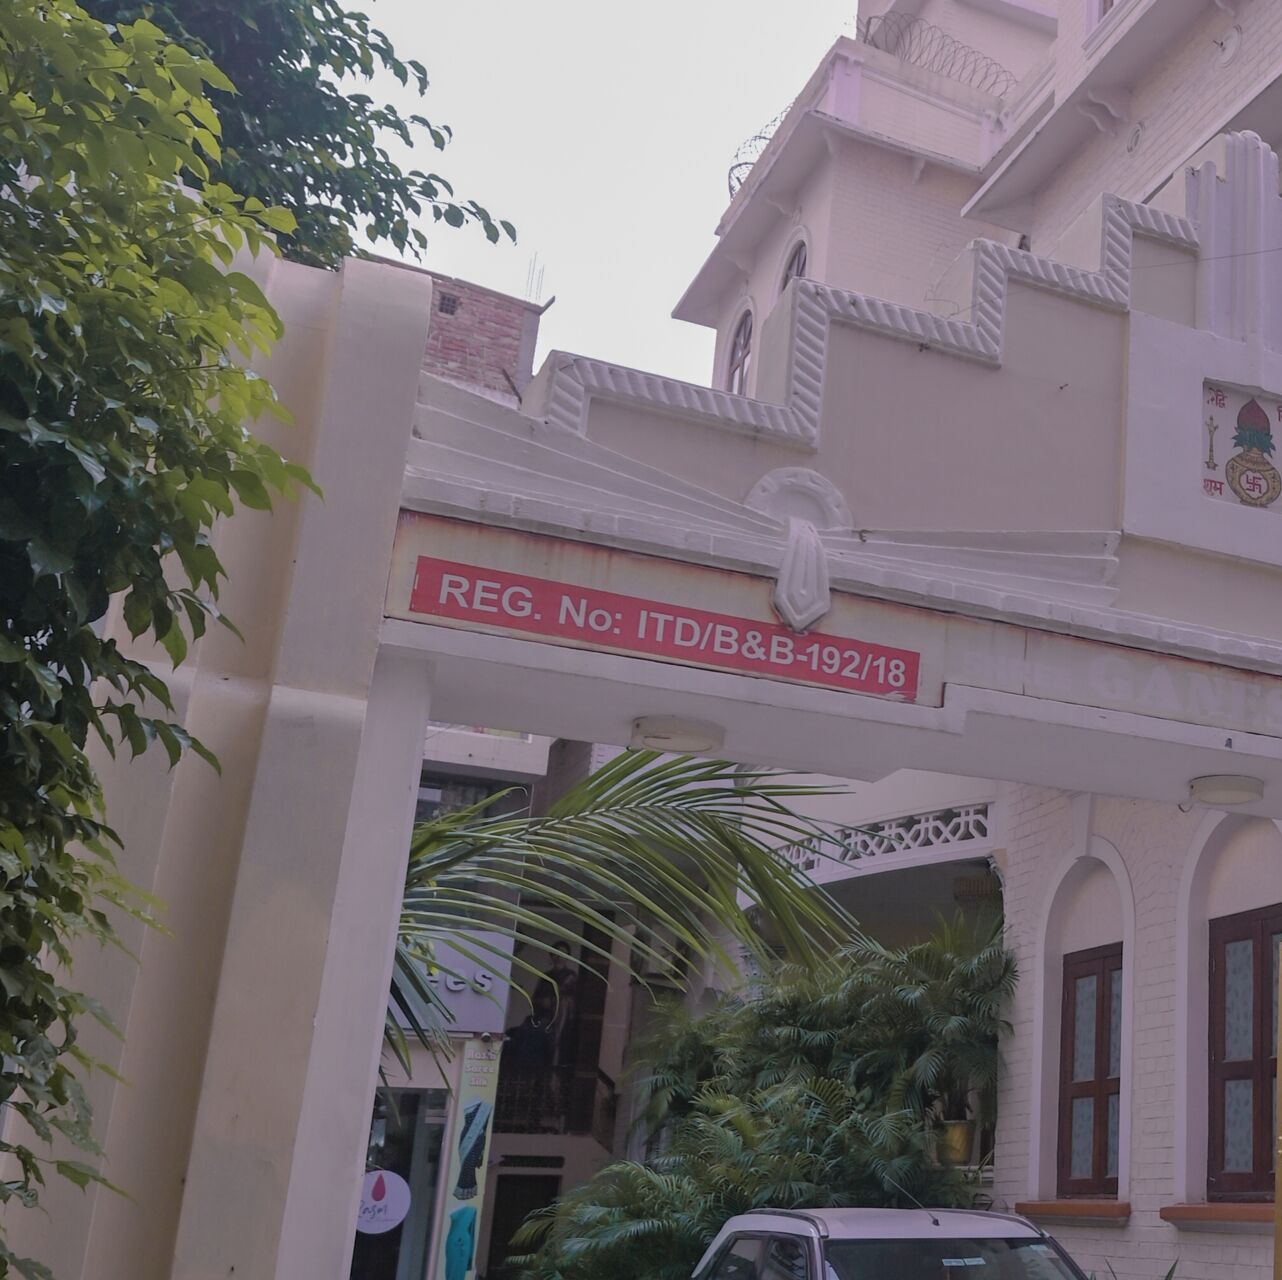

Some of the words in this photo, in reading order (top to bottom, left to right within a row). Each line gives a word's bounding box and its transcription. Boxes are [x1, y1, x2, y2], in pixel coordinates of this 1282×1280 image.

[438, 573, 542, 620] REG.
[558, 595, 622, 636] No:
[638, 610, 906, 687] ITD/B&B-192/18
